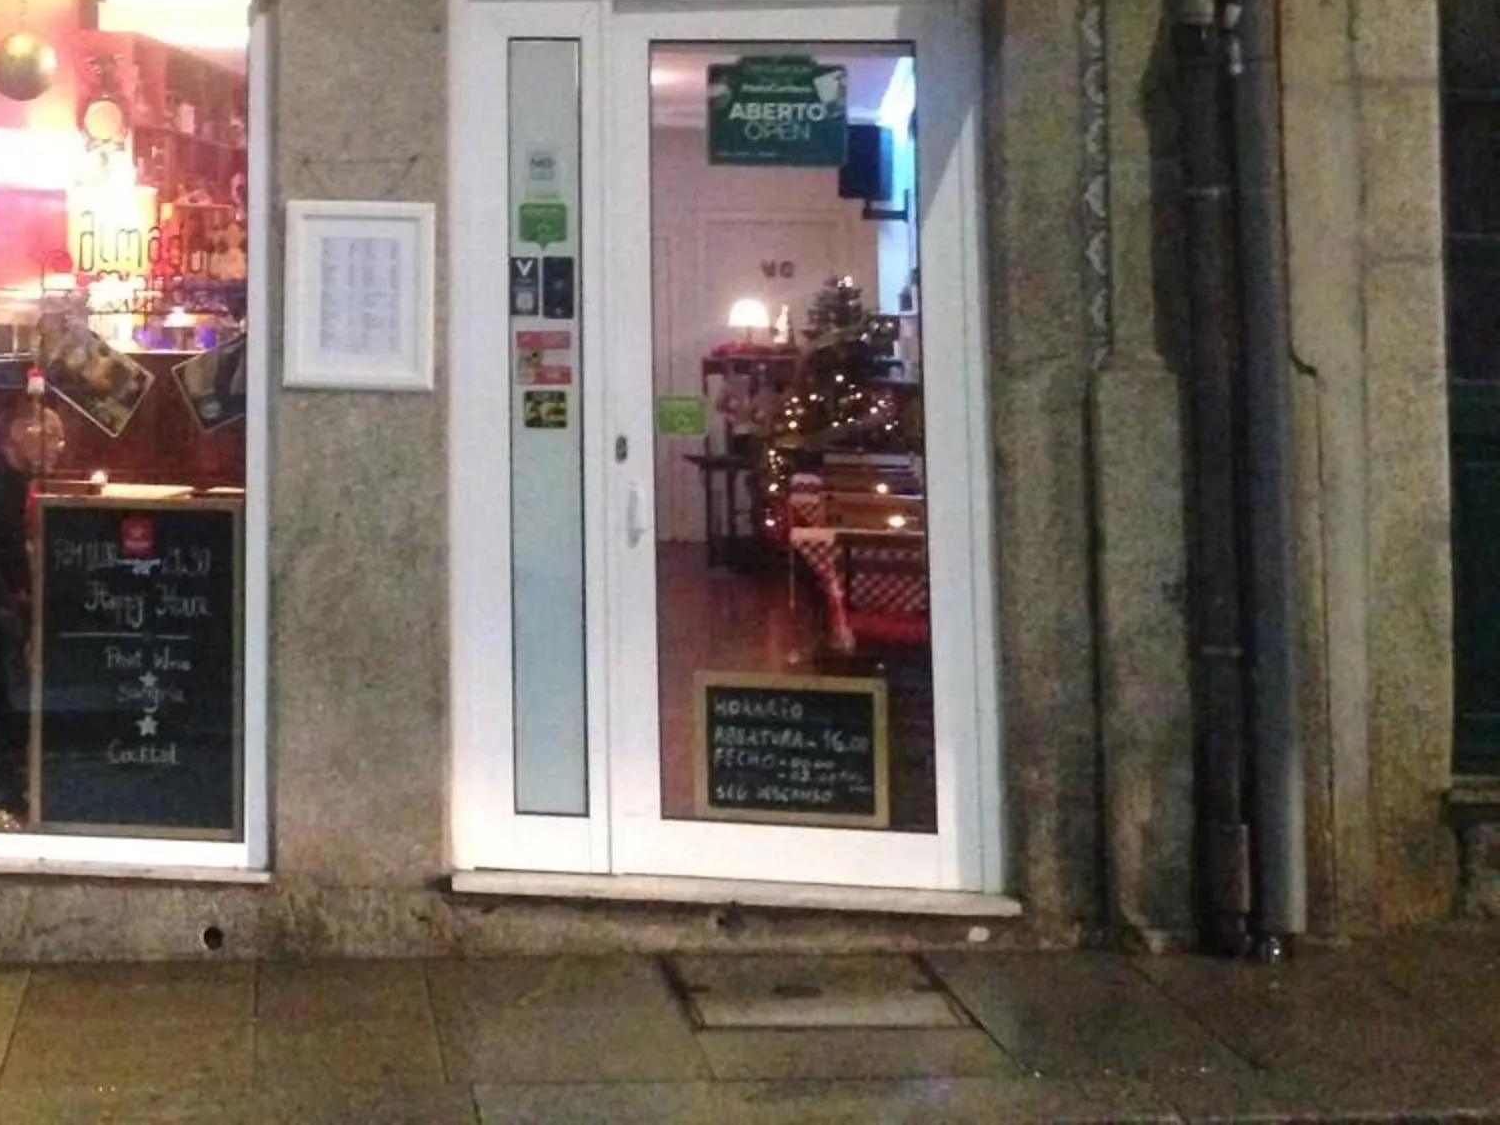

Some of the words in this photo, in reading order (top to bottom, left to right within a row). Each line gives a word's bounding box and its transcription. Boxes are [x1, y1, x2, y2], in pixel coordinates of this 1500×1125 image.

[728, 102, 828, 122] ABERTO
[744, 122, 811, 141] OPEN
[84, 579, 145, 629] Happy
[154, 582, 212, 618] Hour
